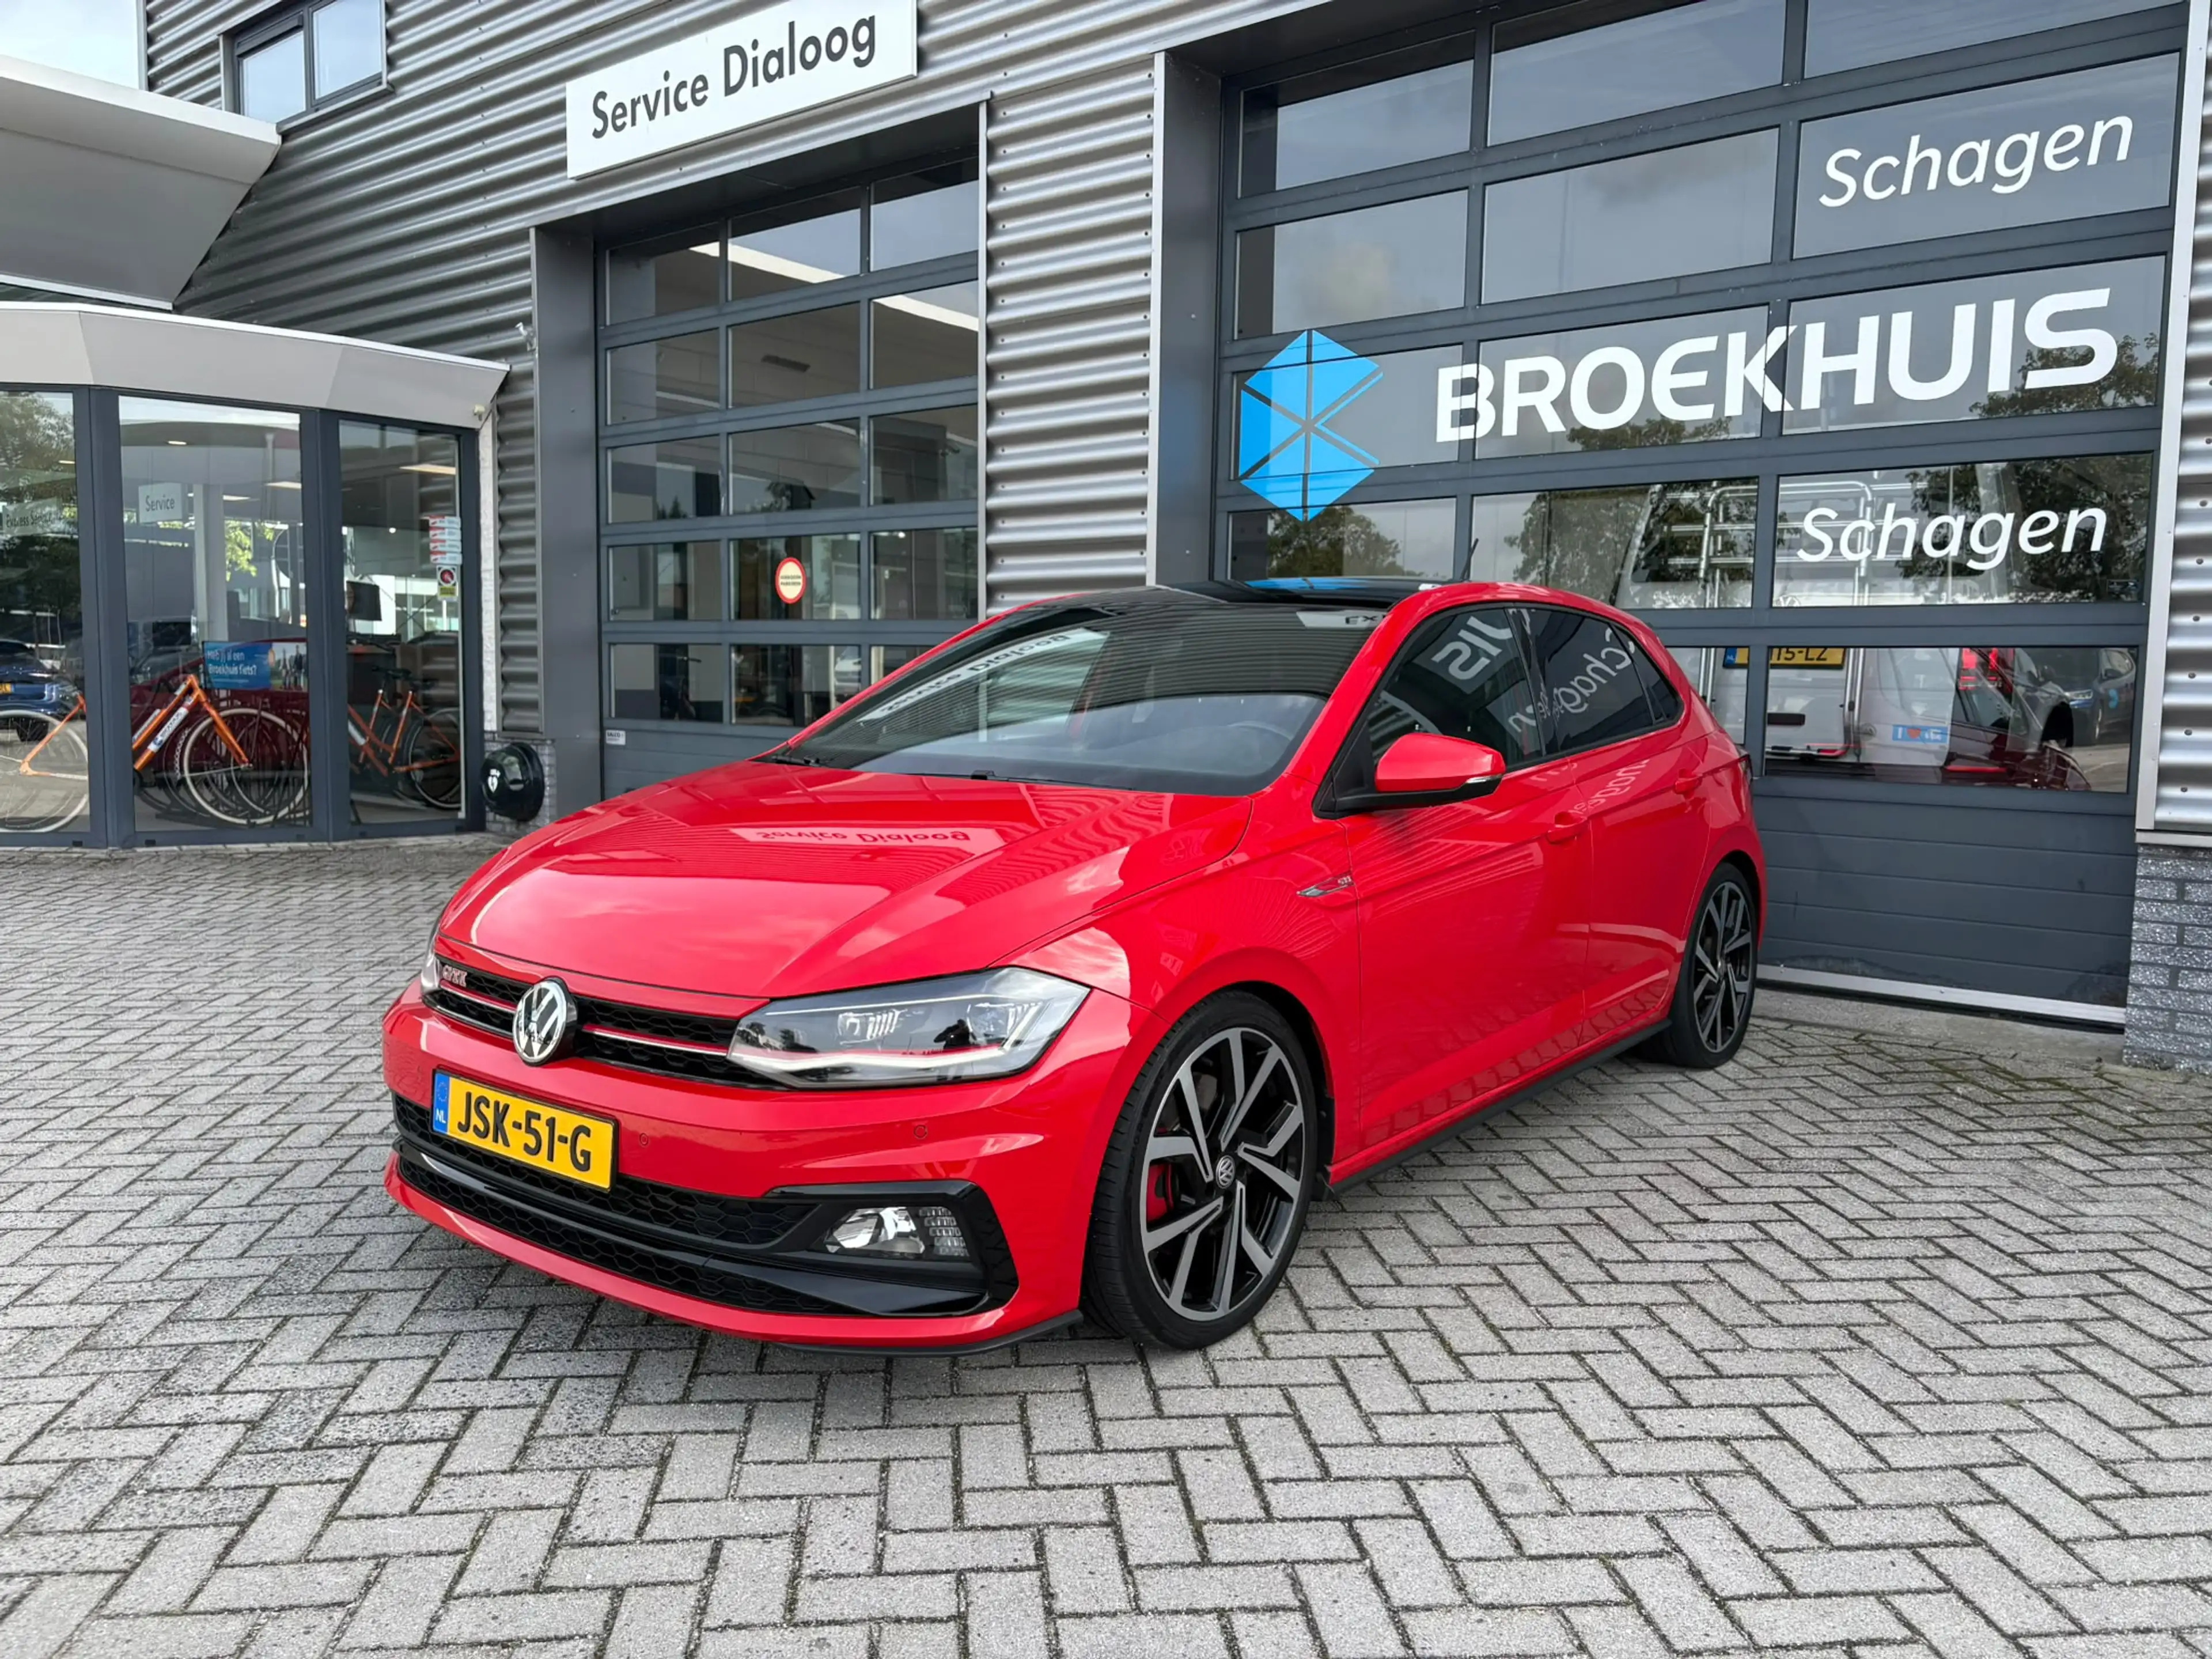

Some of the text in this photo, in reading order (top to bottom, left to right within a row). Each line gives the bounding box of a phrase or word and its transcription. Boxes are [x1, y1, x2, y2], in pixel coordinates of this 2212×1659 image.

[592, 15, 876, 139] Service Dialoog
[1819, 115, 2133, 207] Schagen
[1435, 287, 2118, 443] BROEKHUIS
[145, 495, 175, 512] Service
[1797, 503, 2108, 570] Schagen
[442, 964, 468, 988] GTI
[435, 1108, 447, 1124] NL
[457, 1091, 592, 1172] JSK-51-G
